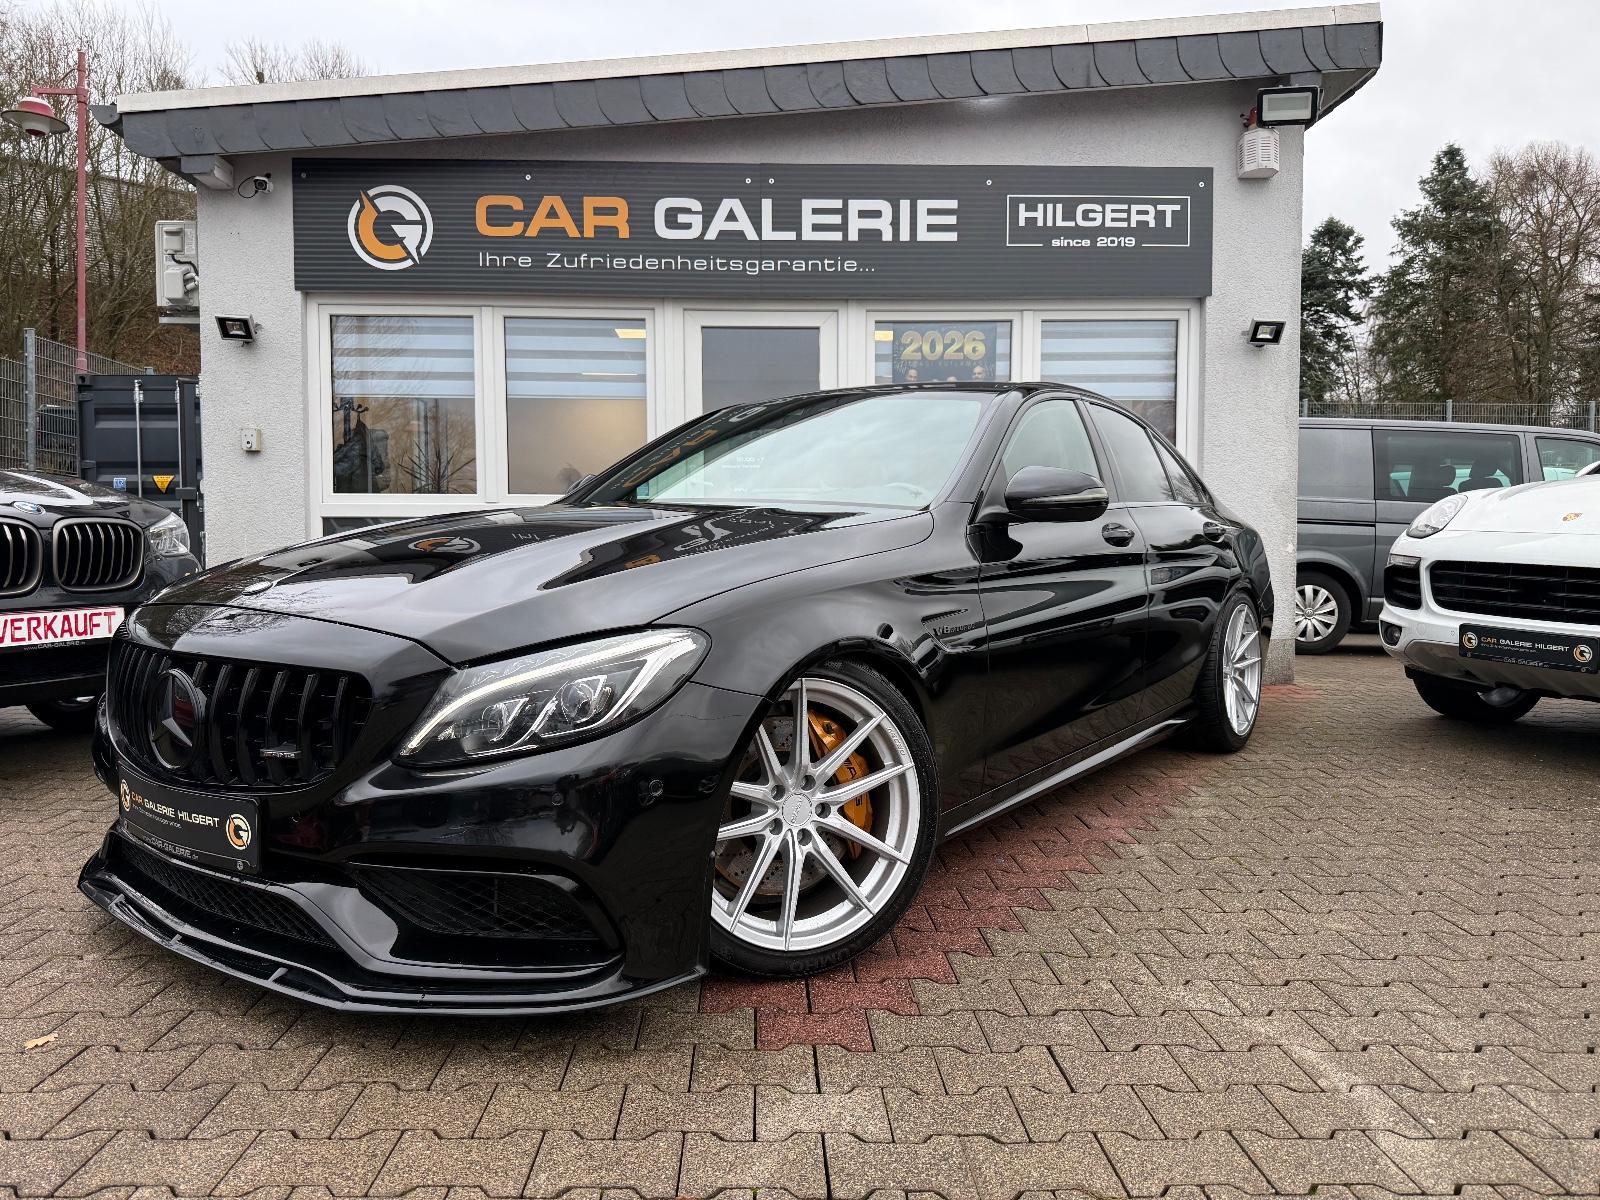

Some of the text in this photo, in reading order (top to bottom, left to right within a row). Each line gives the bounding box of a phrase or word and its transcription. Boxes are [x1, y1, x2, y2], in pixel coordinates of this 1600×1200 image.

[475, 194, 959, 242] CAR GALERIE
[1018, 203, 1181, 228] HILGERT
[1051, 236, 1136, 247] since 2019
[478, 251, 876, 275] Ihre Zufriedenheitsgarantie...
[900, 330, 986, 361] 2026
[1499, 639, 1533, 648] GALERIE
[1534, 643, 1570, 652] HILGERT
[131, 791, 144, 806] CAR
[144, 798, 176, 818] GALERIE
[177, 809, 220, 828] HILGERT
